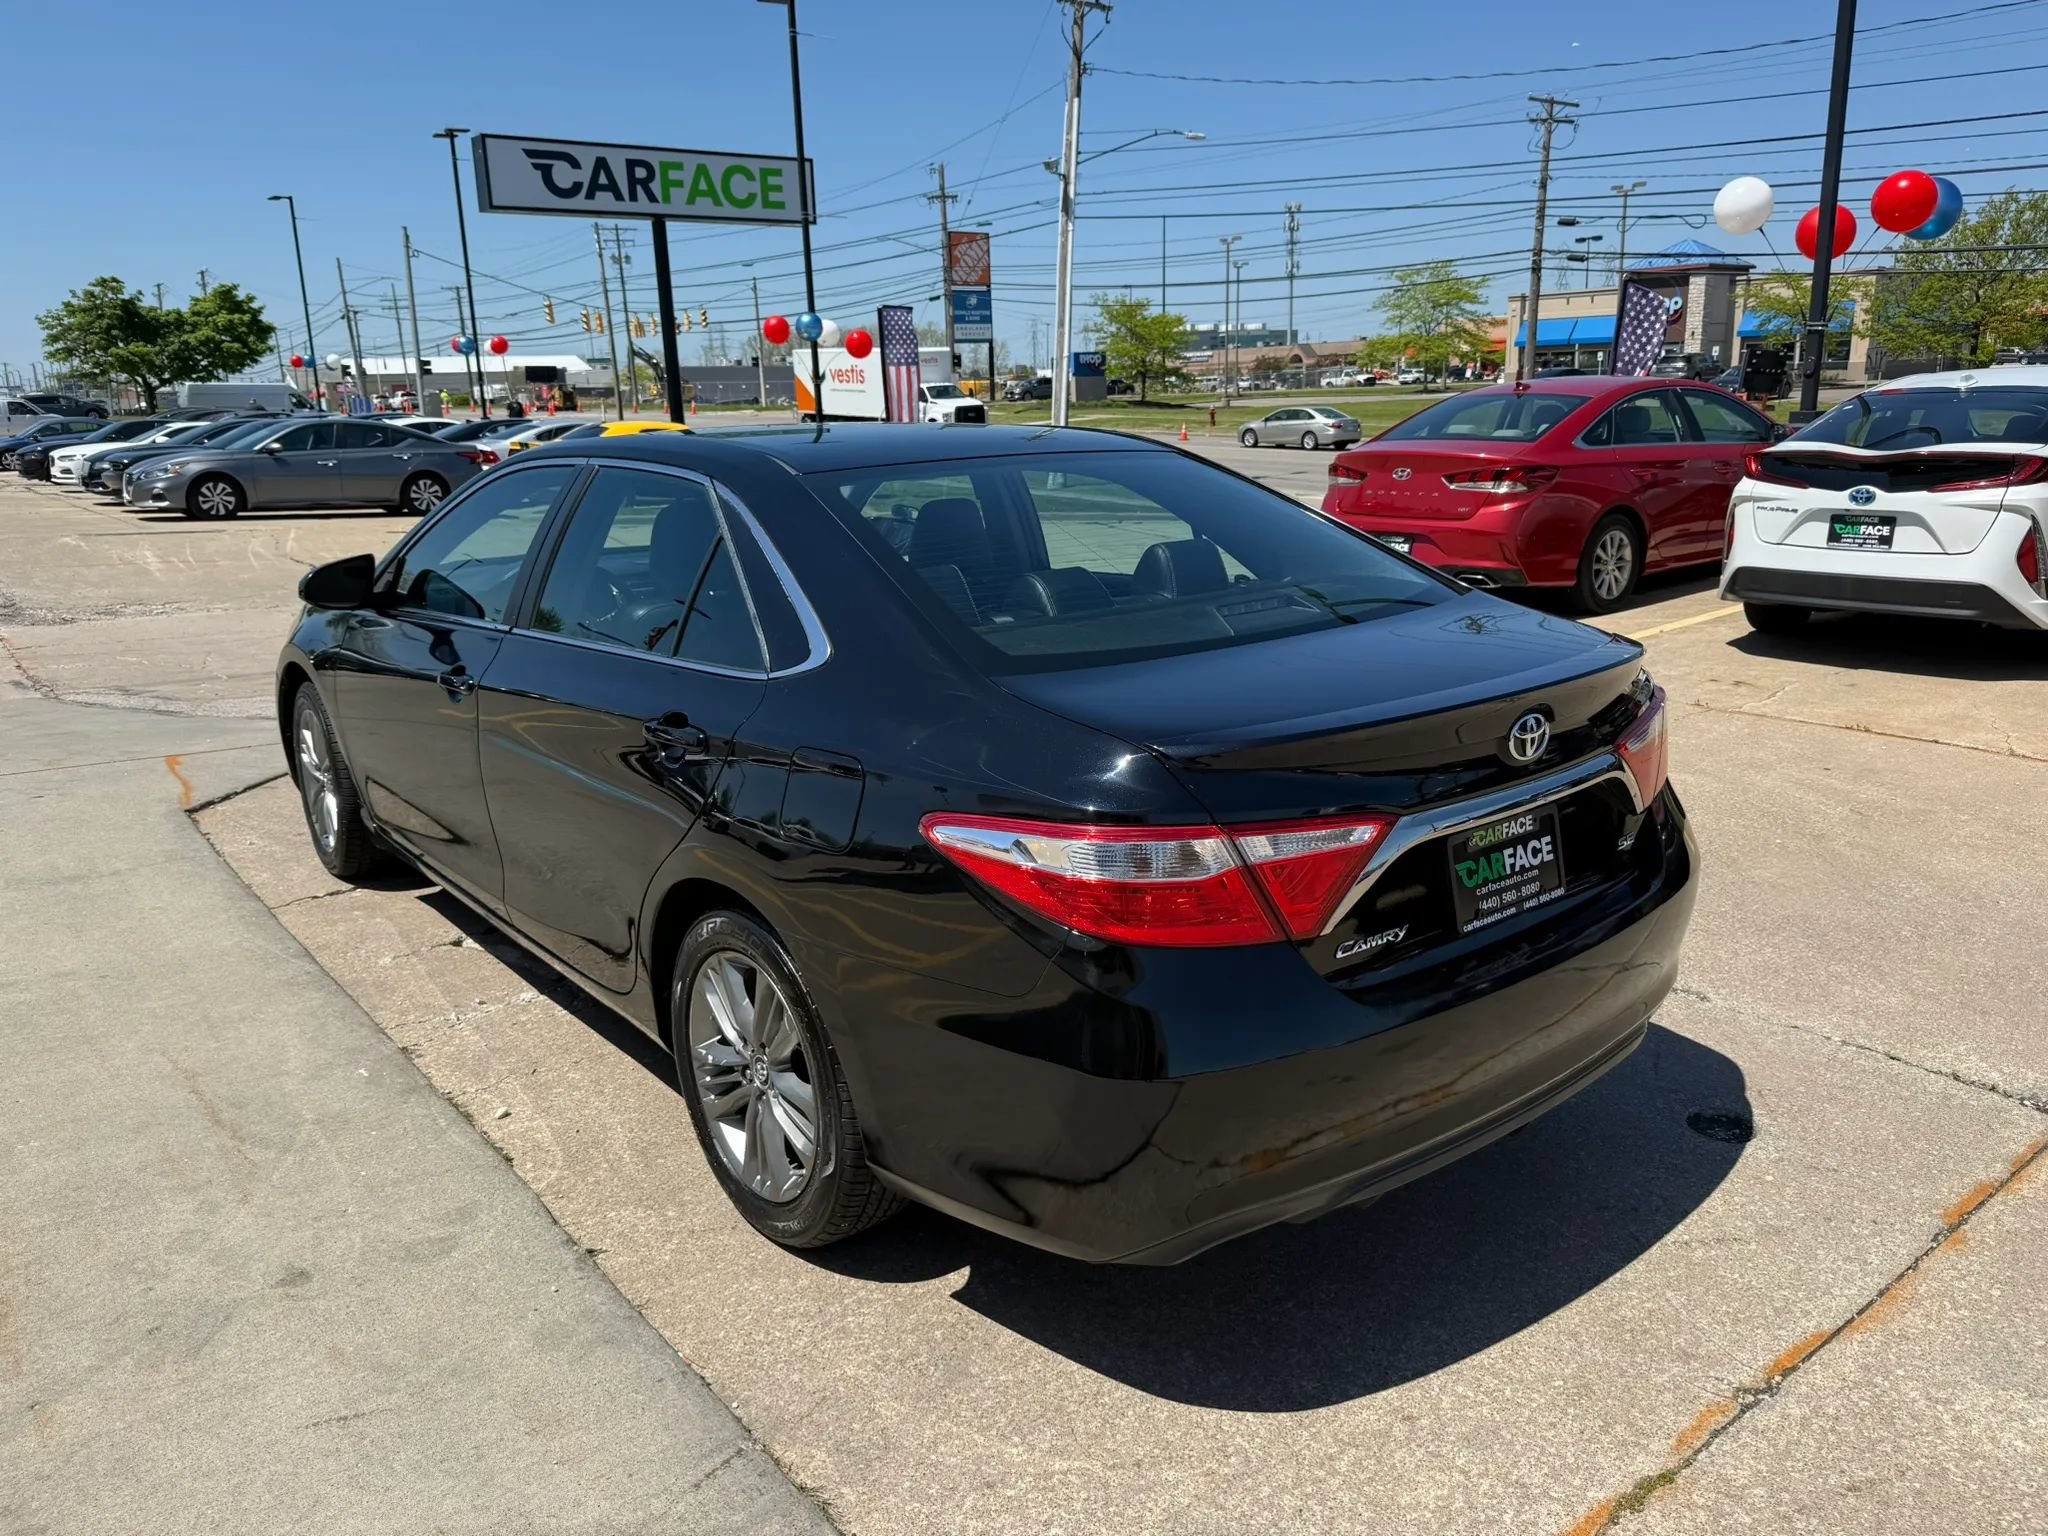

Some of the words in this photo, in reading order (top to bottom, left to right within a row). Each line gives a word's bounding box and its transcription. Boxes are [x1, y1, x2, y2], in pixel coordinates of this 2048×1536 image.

[521, 148, 786, 210] CARFACE
[829, 365, 865, 384] vestis
[1833, 523, 1890, 536] CARFACE
[1472, 815, 1533, 846] CARFACE
[1617, 832, 1635, 851] SE
[1455, 835, 1554, 888] CARFACE
[1476, 869, 1539, 896] carfaceauto.com
[1479, 895, 1501, 911] (440)
[1463, 906, 1517, 932] carfaceauto.com
[1336, 924, 1409, 958] CAMRY
